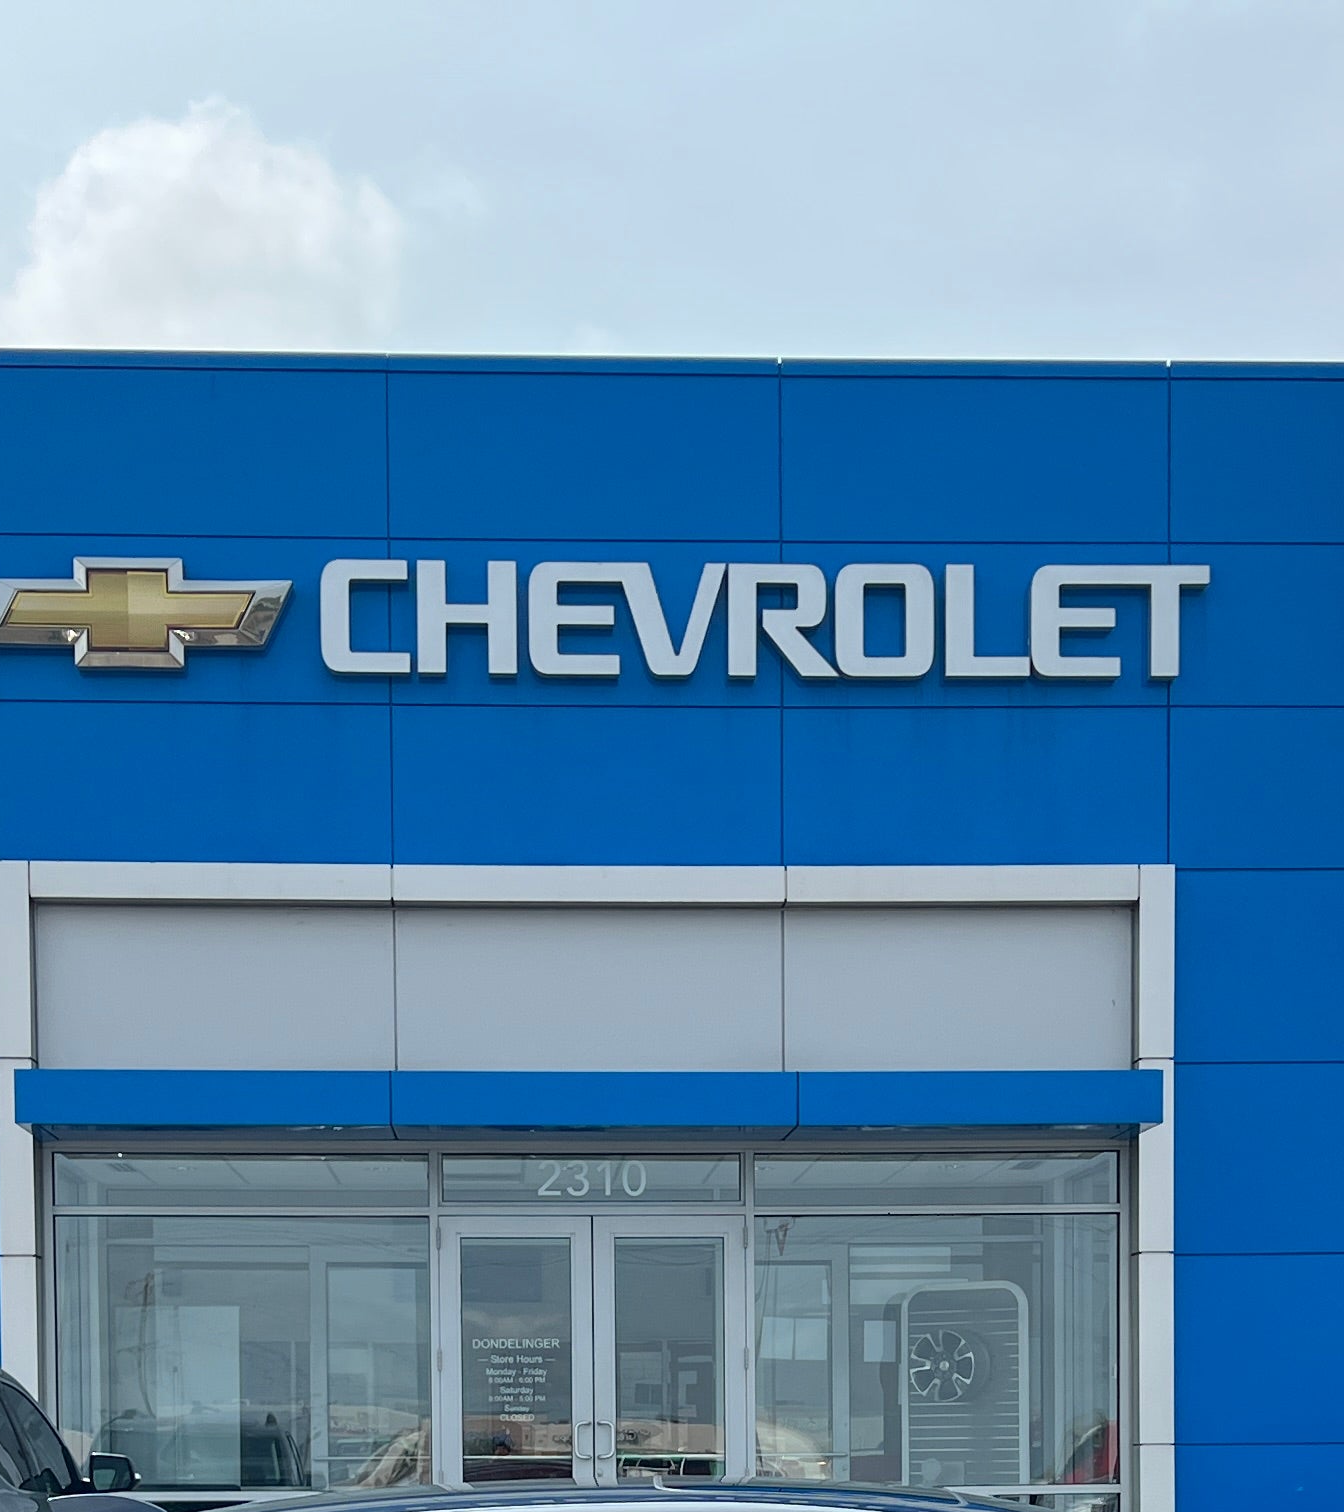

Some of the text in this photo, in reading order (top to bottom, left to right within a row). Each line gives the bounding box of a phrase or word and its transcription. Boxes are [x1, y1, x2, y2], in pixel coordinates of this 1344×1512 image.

[320, 558, 1211, 681] CHEVROLET
[537, 1160, 647, 1196] 2310
[472, 1338, 560, 1349] DONDELINGER
[490, 1354, 543, 1364] Store Hours
[486, 1367, 516, 1377] Monday
[523, 1367, 547, 1377] Friday
[499, 1386, 533, 1395] Saturday
[504, 1404, 530, 1413] Sunday
[499, 1414, 535, 1422] CLOSED
